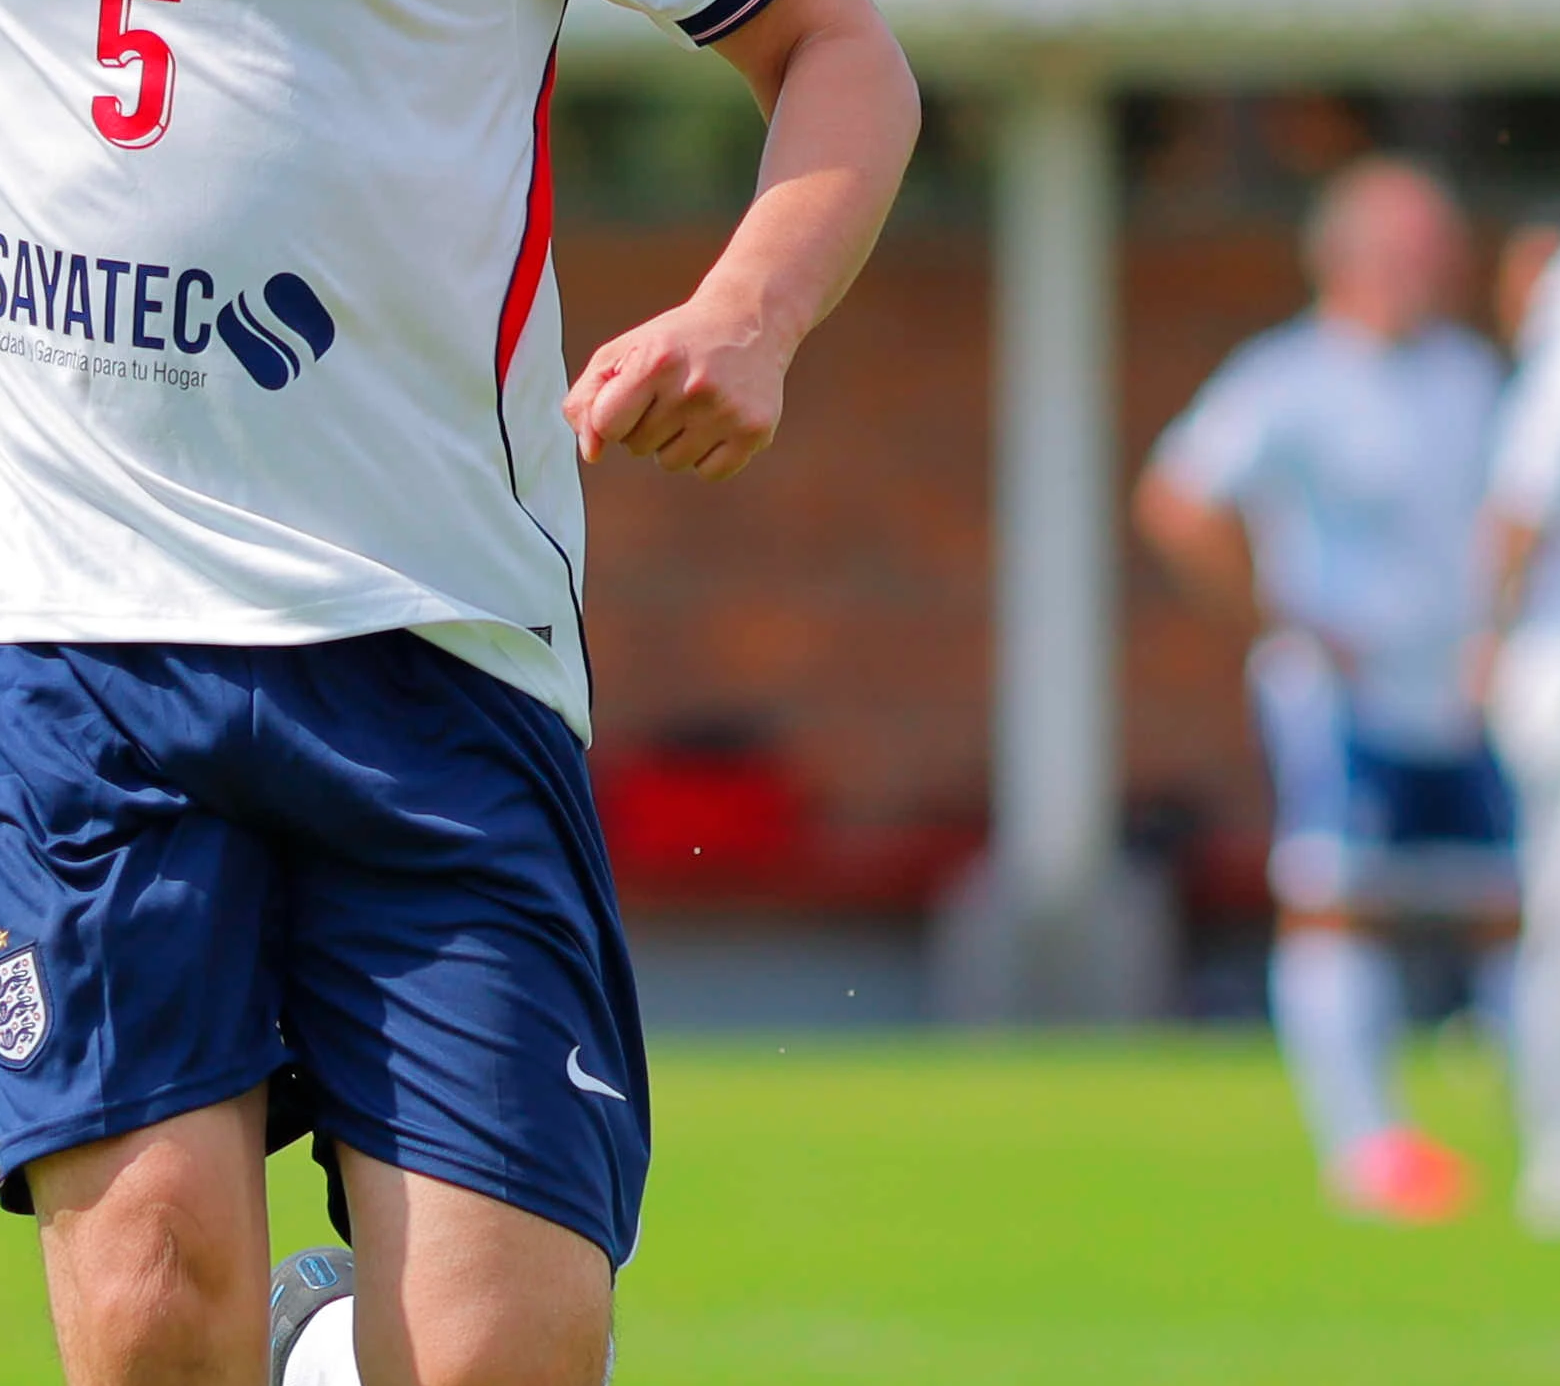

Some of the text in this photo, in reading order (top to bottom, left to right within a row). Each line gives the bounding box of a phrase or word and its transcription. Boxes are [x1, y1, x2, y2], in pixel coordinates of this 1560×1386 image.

[93, 357, 127, 379] para
[132, 359, 148, 381] tu
[153, 361, 209, 391] Hogar
